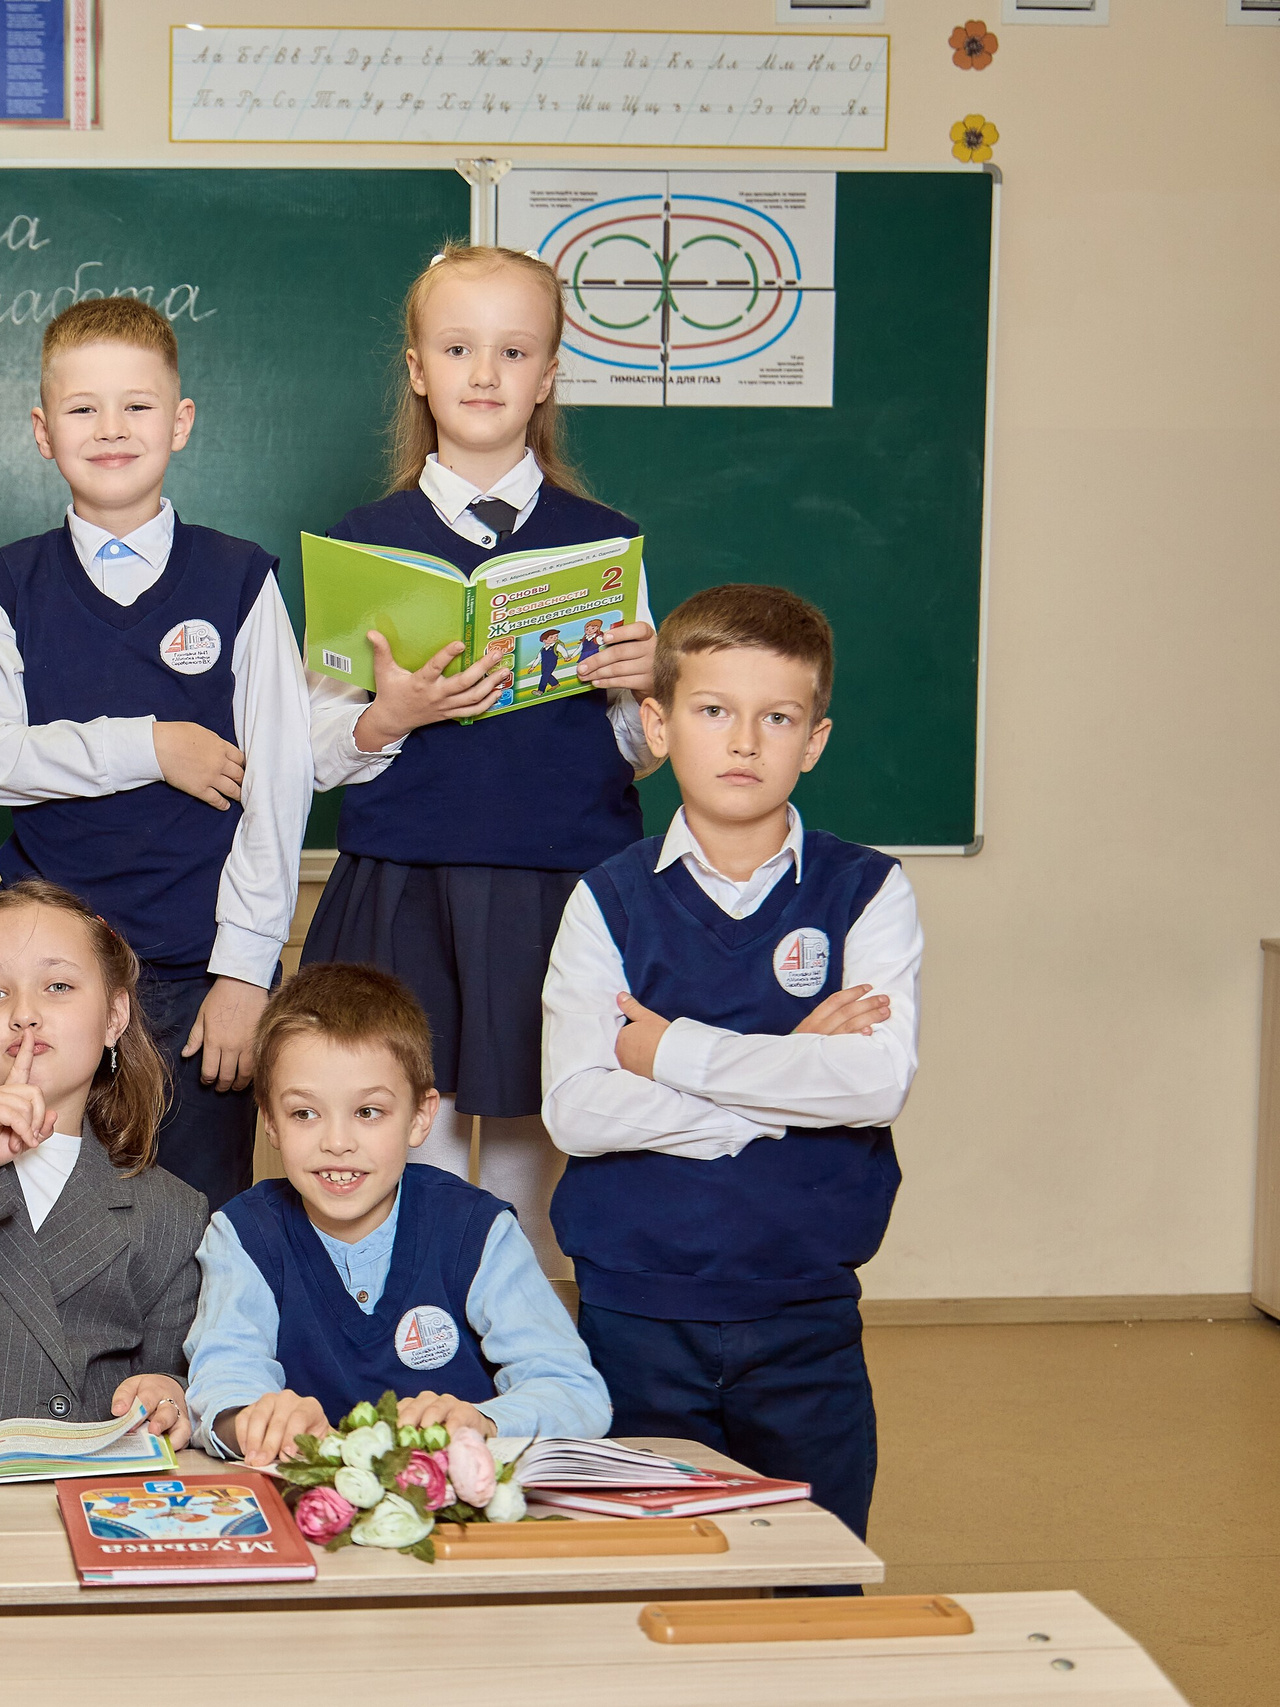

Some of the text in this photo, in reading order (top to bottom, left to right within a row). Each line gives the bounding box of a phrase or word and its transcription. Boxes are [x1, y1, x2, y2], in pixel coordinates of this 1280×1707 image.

[610, 374, 721, 385] ГИМНАСТИКА ДЛЯ ГЛАЗ
[601, 566, 624, 593] 2
[491, 584, 549, 608] Основы
[491, 589, 588, 623] Безопасности
[489, 594, 623, 638] Жизнедеятельности
[98, 1539, 279, 1555] Музыка
